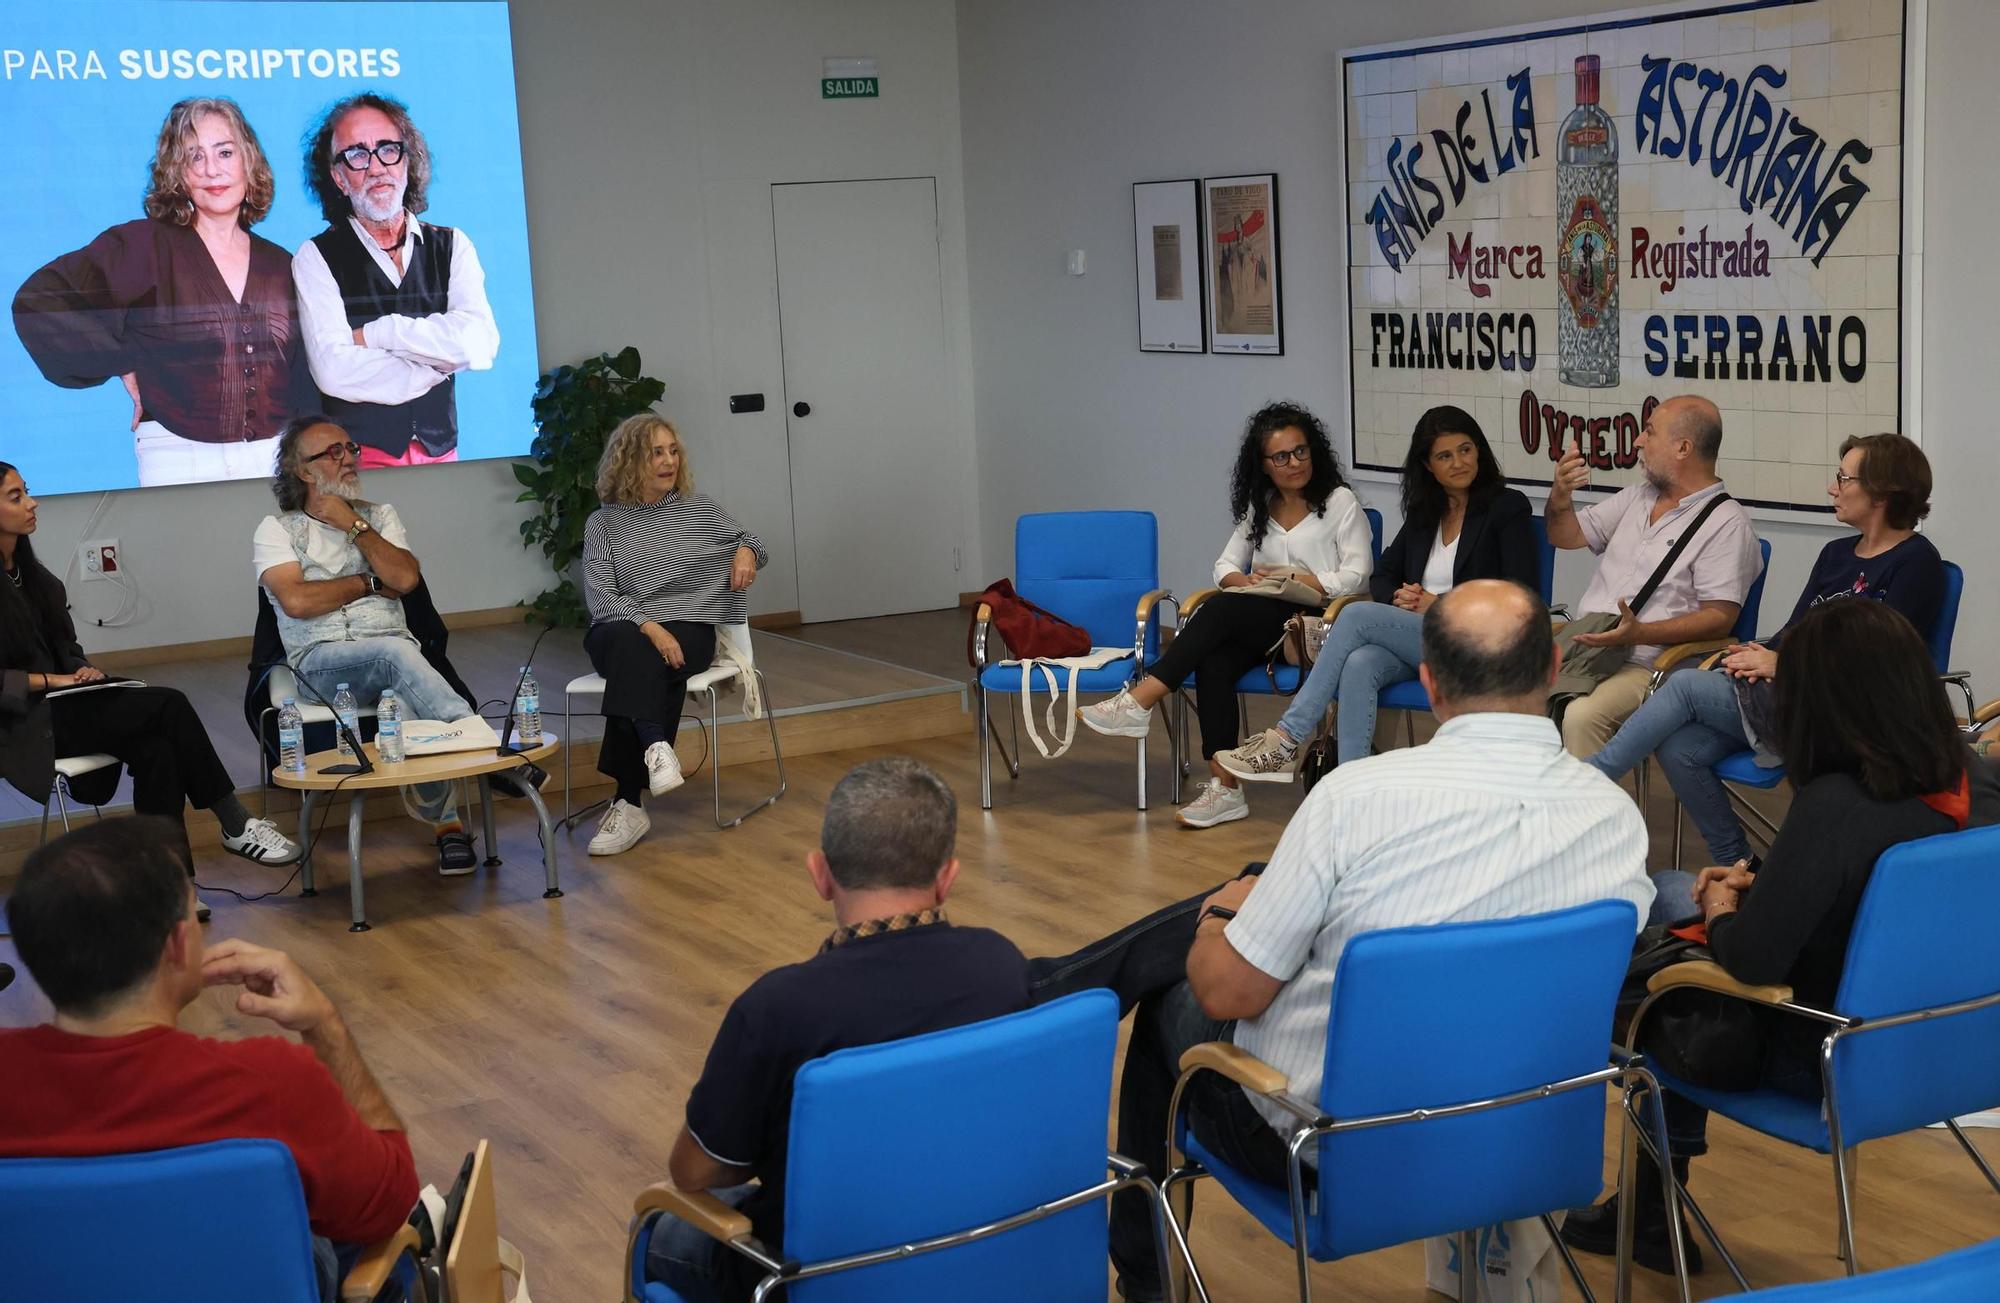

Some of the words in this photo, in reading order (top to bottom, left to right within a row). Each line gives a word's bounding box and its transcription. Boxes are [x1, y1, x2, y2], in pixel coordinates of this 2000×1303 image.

[4, 49, 107, 80] PARA
[120, 48, 401, 79] SUSCRIPTORES
[826, 80, 875, 96] SALIDA
[1365, 137, 1445, 273] ANIS
[1430, 101, 1490, 208] DE
[1481, 66, 1540, 176] LA
[1635, 53, 1873, 269] ASTURIANA
[1447, 231, 1546, 298] Marca
[1630, 223, 1772, 295] Registrada
[1370, 312, 1537, 373] FRANCISCO
[1643, 314, 1867, 384] SERRANO
